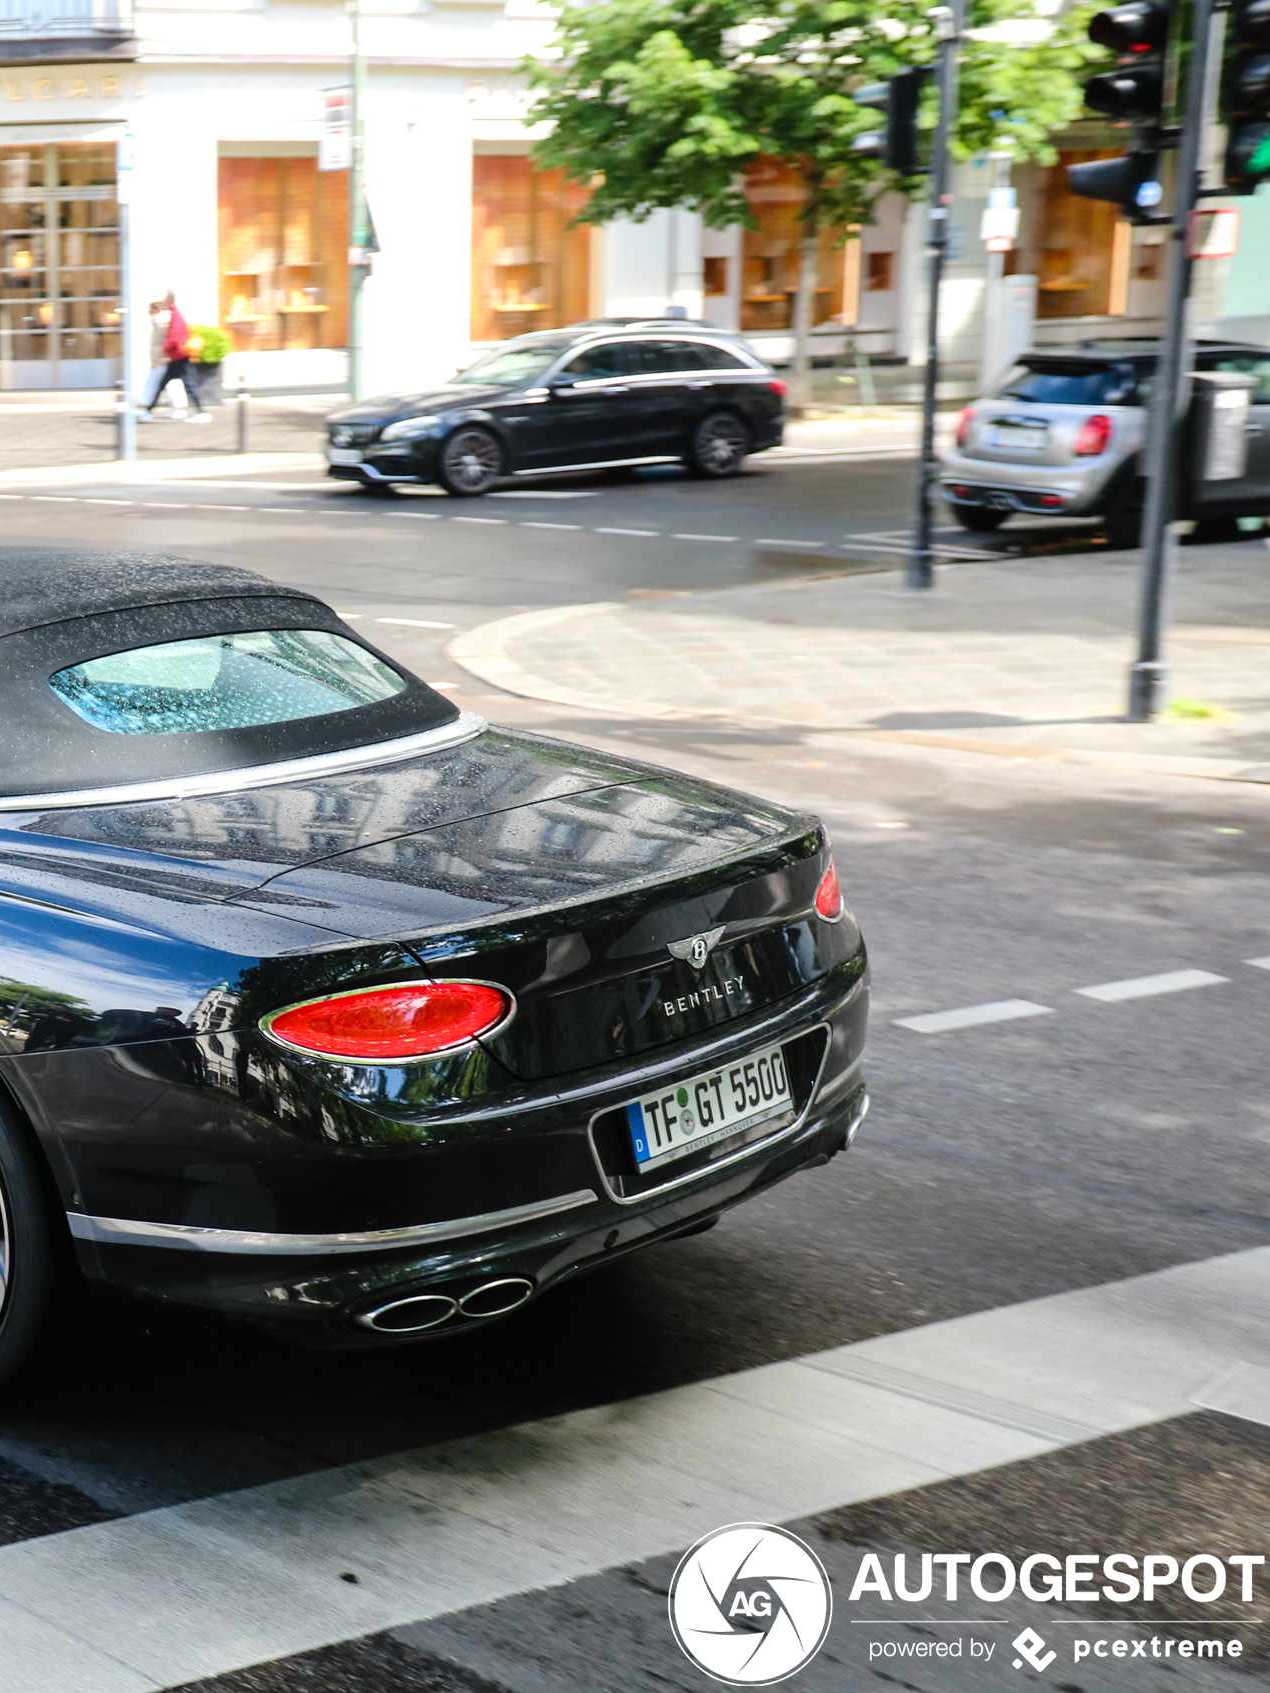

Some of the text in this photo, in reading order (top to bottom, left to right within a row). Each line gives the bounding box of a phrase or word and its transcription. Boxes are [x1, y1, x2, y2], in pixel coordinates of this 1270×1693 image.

[693, 940, 706, 960] B
[663, 975, 744, 1017] BENTLEY
[644, 1052, 787, 1148] TF GT 5500
[635, 1139, 644, 1153] D
[685, 1118, 755, 1153] BENTLEY HANNOVER
